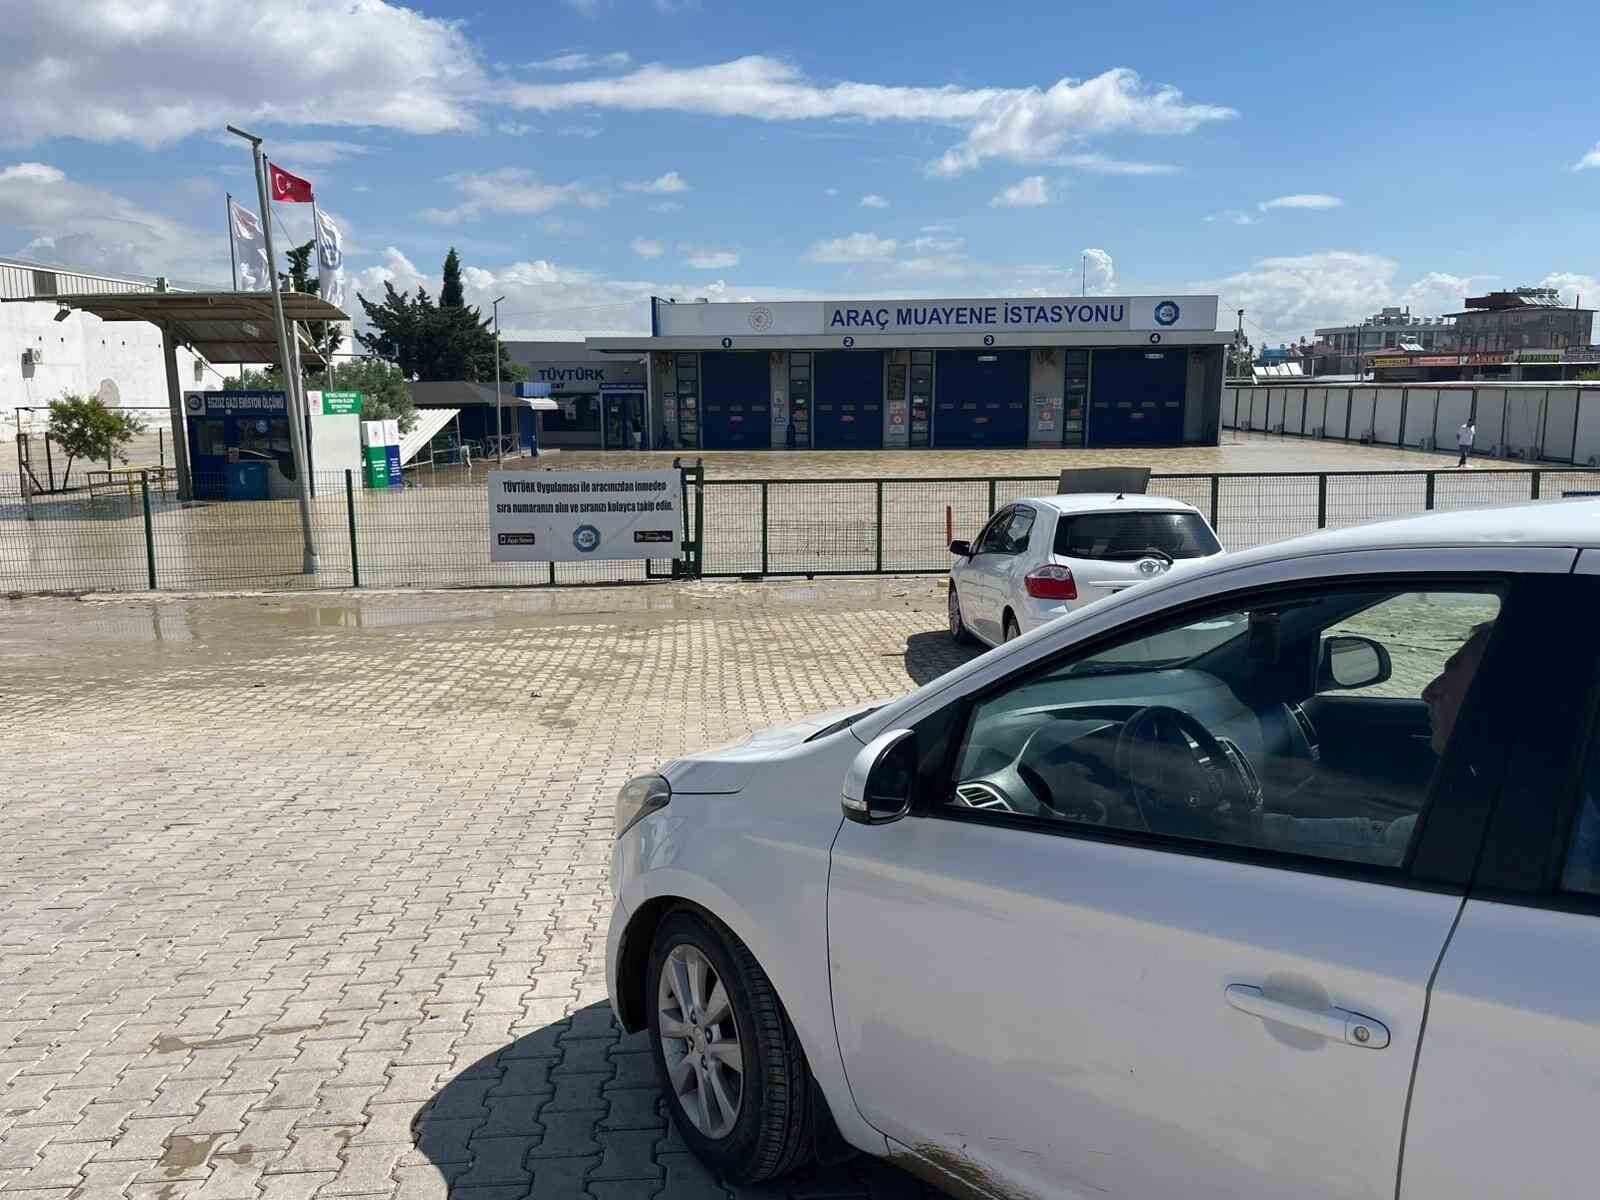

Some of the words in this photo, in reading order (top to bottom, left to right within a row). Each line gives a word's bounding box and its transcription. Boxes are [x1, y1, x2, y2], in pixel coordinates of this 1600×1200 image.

[830, 308, 889, 330] ARAÇ
[896, 306, 996, 326] MUAYENE
[1003, 302, 1124, 325] İSTASYONU
[538, 367, 605, 381] TÜVTÜRK
[503, 480, 535, 493] TÜVTÜRK
[536, 480, 580, 494] Uygulaması
[580, 480, 591, 493] ile
[496, 503, 512, 513] sıra
[570, 503, 579, 513] ve
[607, 501, 636, 514] kolayca
